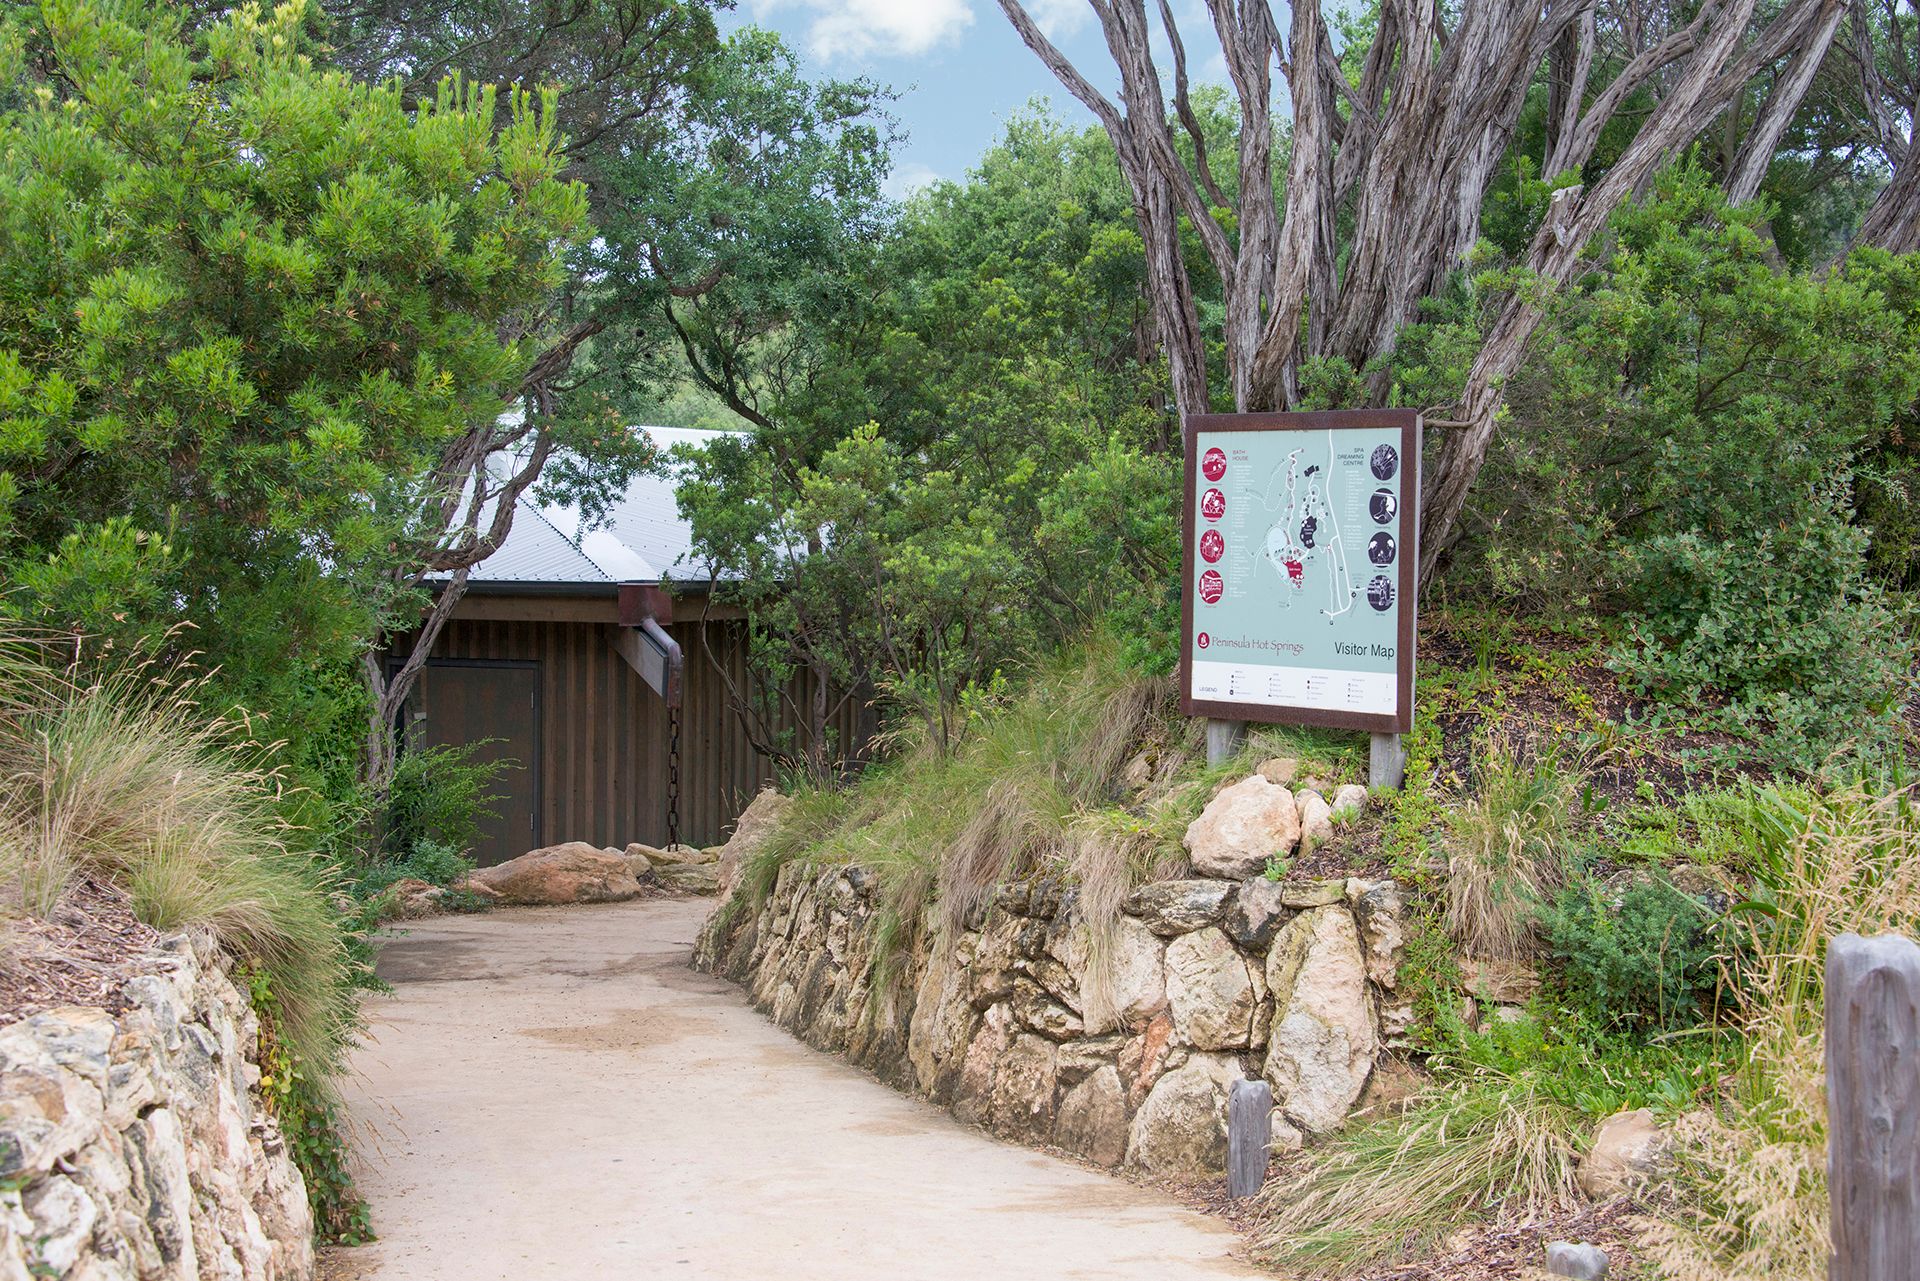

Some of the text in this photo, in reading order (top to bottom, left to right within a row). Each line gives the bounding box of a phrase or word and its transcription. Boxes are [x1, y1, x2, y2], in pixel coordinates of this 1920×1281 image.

[1211, 635, 1304, 656] Peninsula Hot Springs
[1334, 641, 1395, 660] Visitor Map
